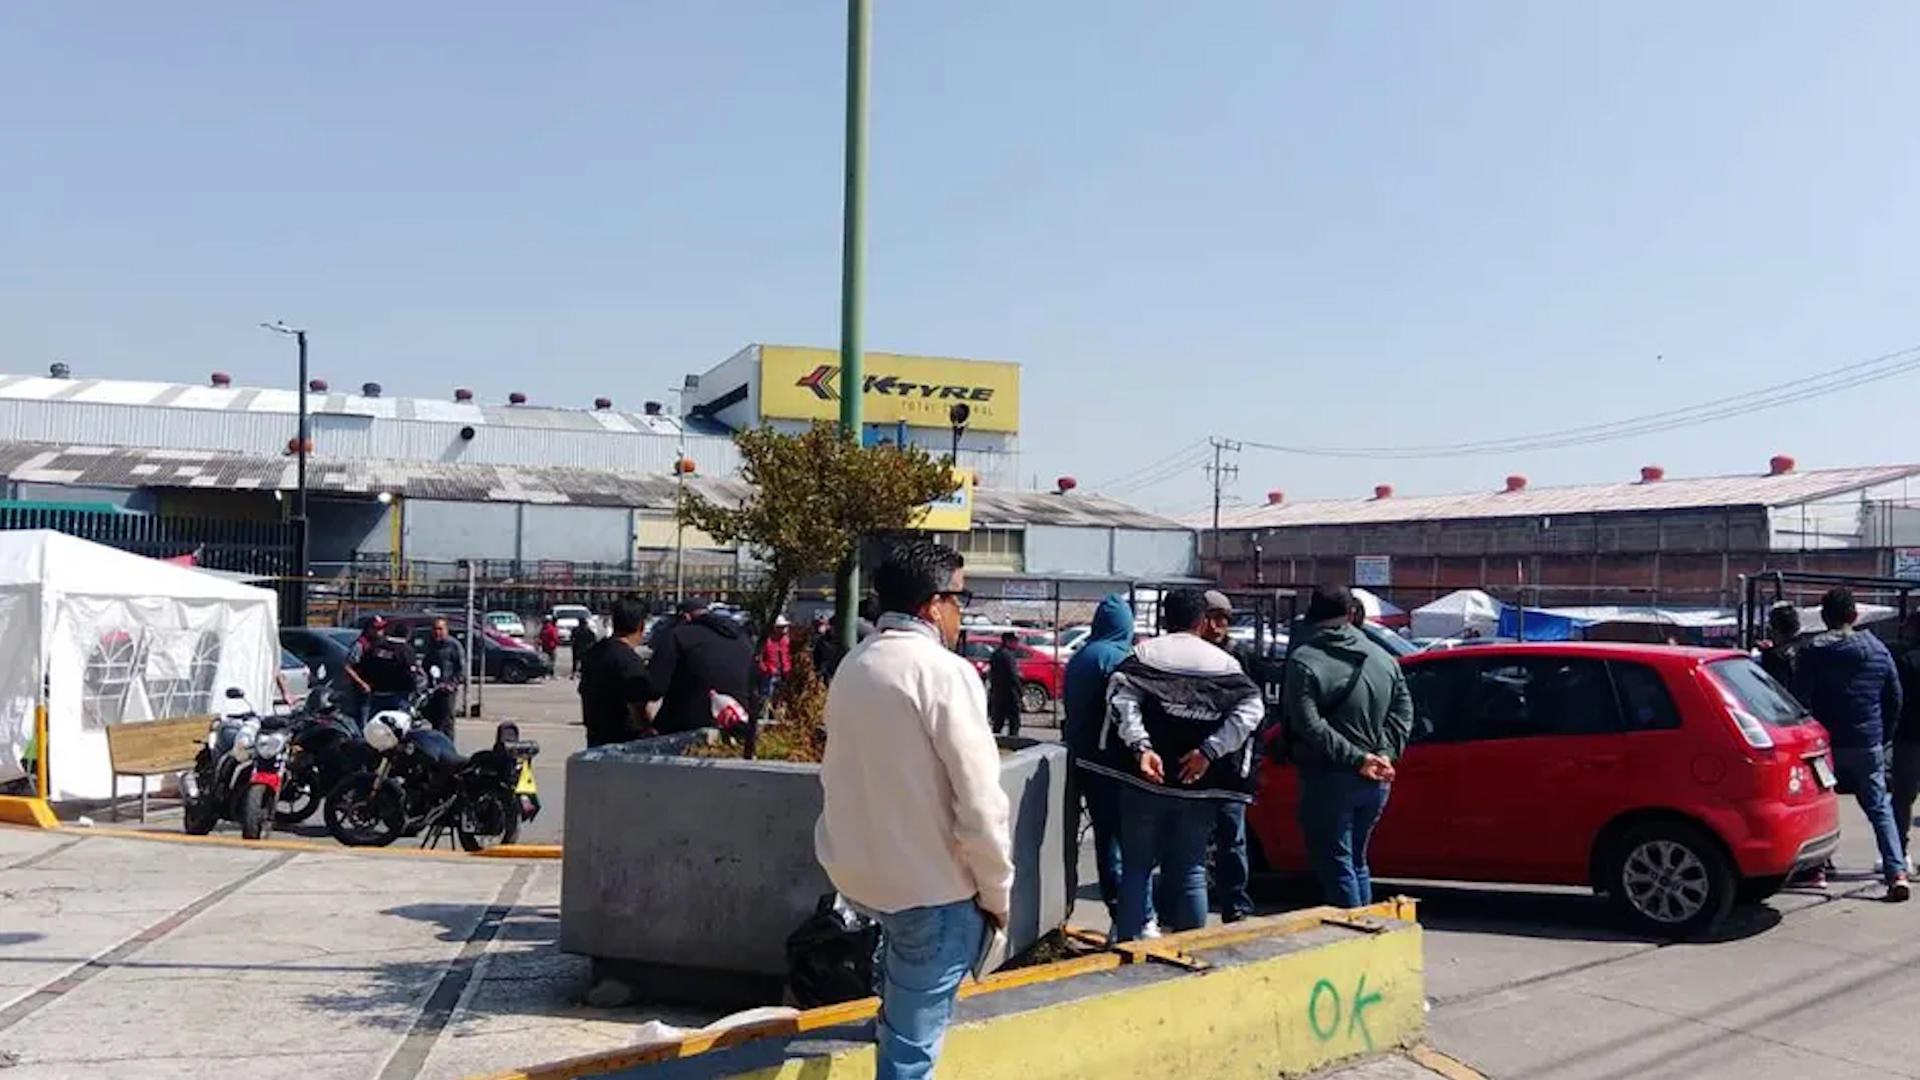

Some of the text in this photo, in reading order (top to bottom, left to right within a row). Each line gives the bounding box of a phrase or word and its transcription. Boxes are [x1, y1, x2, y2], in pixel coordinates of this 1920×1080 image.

[862, 374, 995, 401] KTYRE
[902, 400, 937, 413] TOTAL
[1308, 974, 1381, 1051] OK
